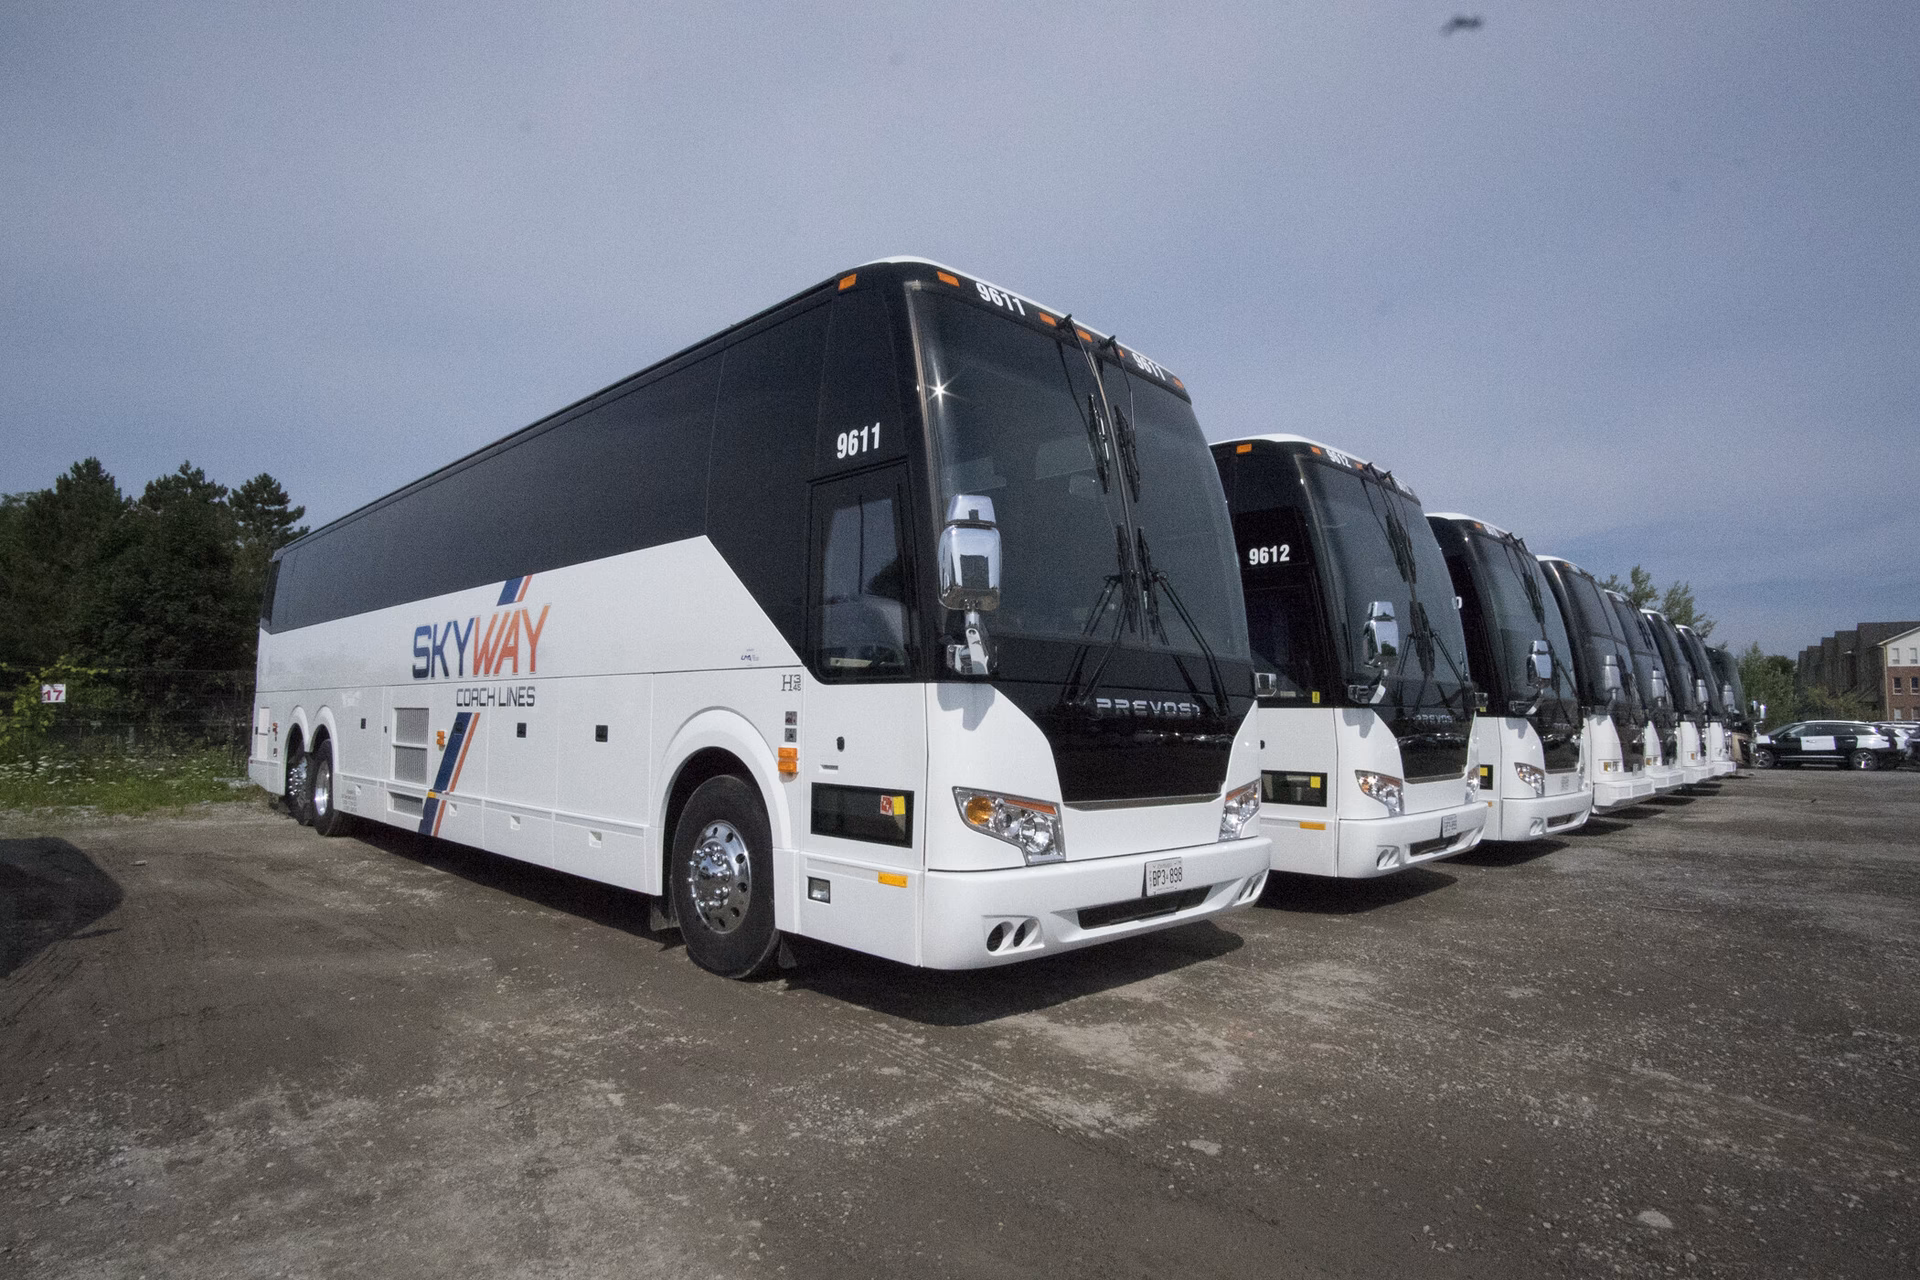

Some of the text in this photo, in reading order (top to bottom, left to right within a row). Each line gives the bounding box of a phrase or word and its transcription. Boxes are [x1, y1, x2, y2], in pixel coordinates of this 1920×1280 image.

[976, 282, 1025, 316] 9611
[1131, 352, 1166, 381] 9611
[836, 421, 881, 459] 9611
[1249, 544, 1290, 566] 9612
[412, 603, 552, 680] SKYWAY
[43, 690, 63, 701] 17
[456, 686, 536, 707] COACH LINES
